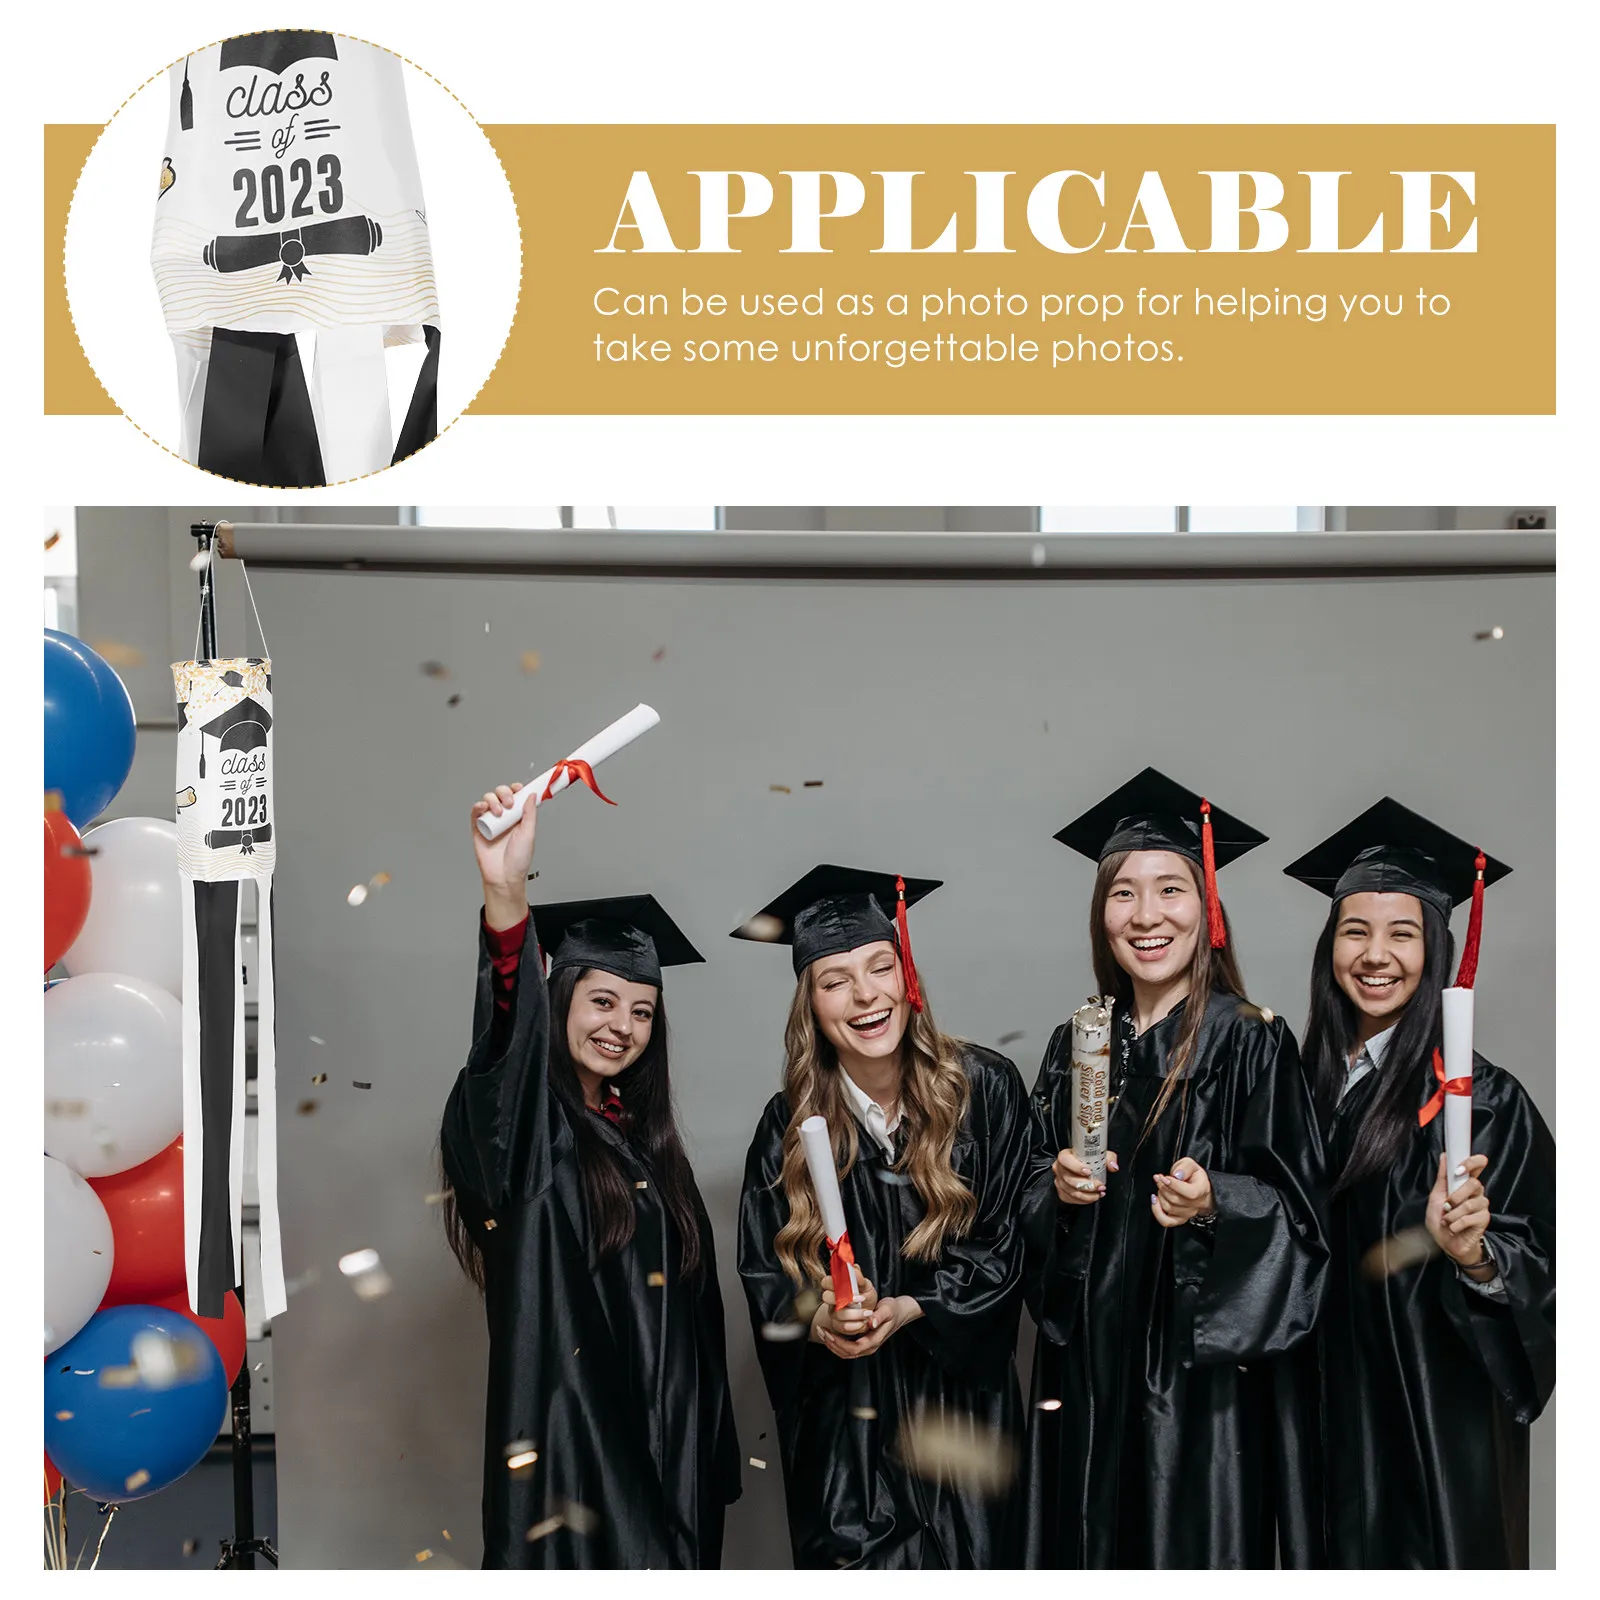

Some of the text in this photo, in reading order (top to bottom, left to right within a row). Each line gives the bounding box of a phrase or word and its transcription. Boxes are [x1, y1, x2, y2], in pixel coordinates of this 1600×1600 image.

[225, 71, 333, 118] class
[271, 113, 300, 159] of
[233, 153, 344, 228] 2023
[221, 752, 266, 775] class
[240, 773, 254, 794] of
[221, 794, 267, 827] 2023
[1080, 1065, 1094, 1102] Silver
[1093, 1070, 1106, 1122] Gold and
[1077, 1103, 1093, 1128] Slip
